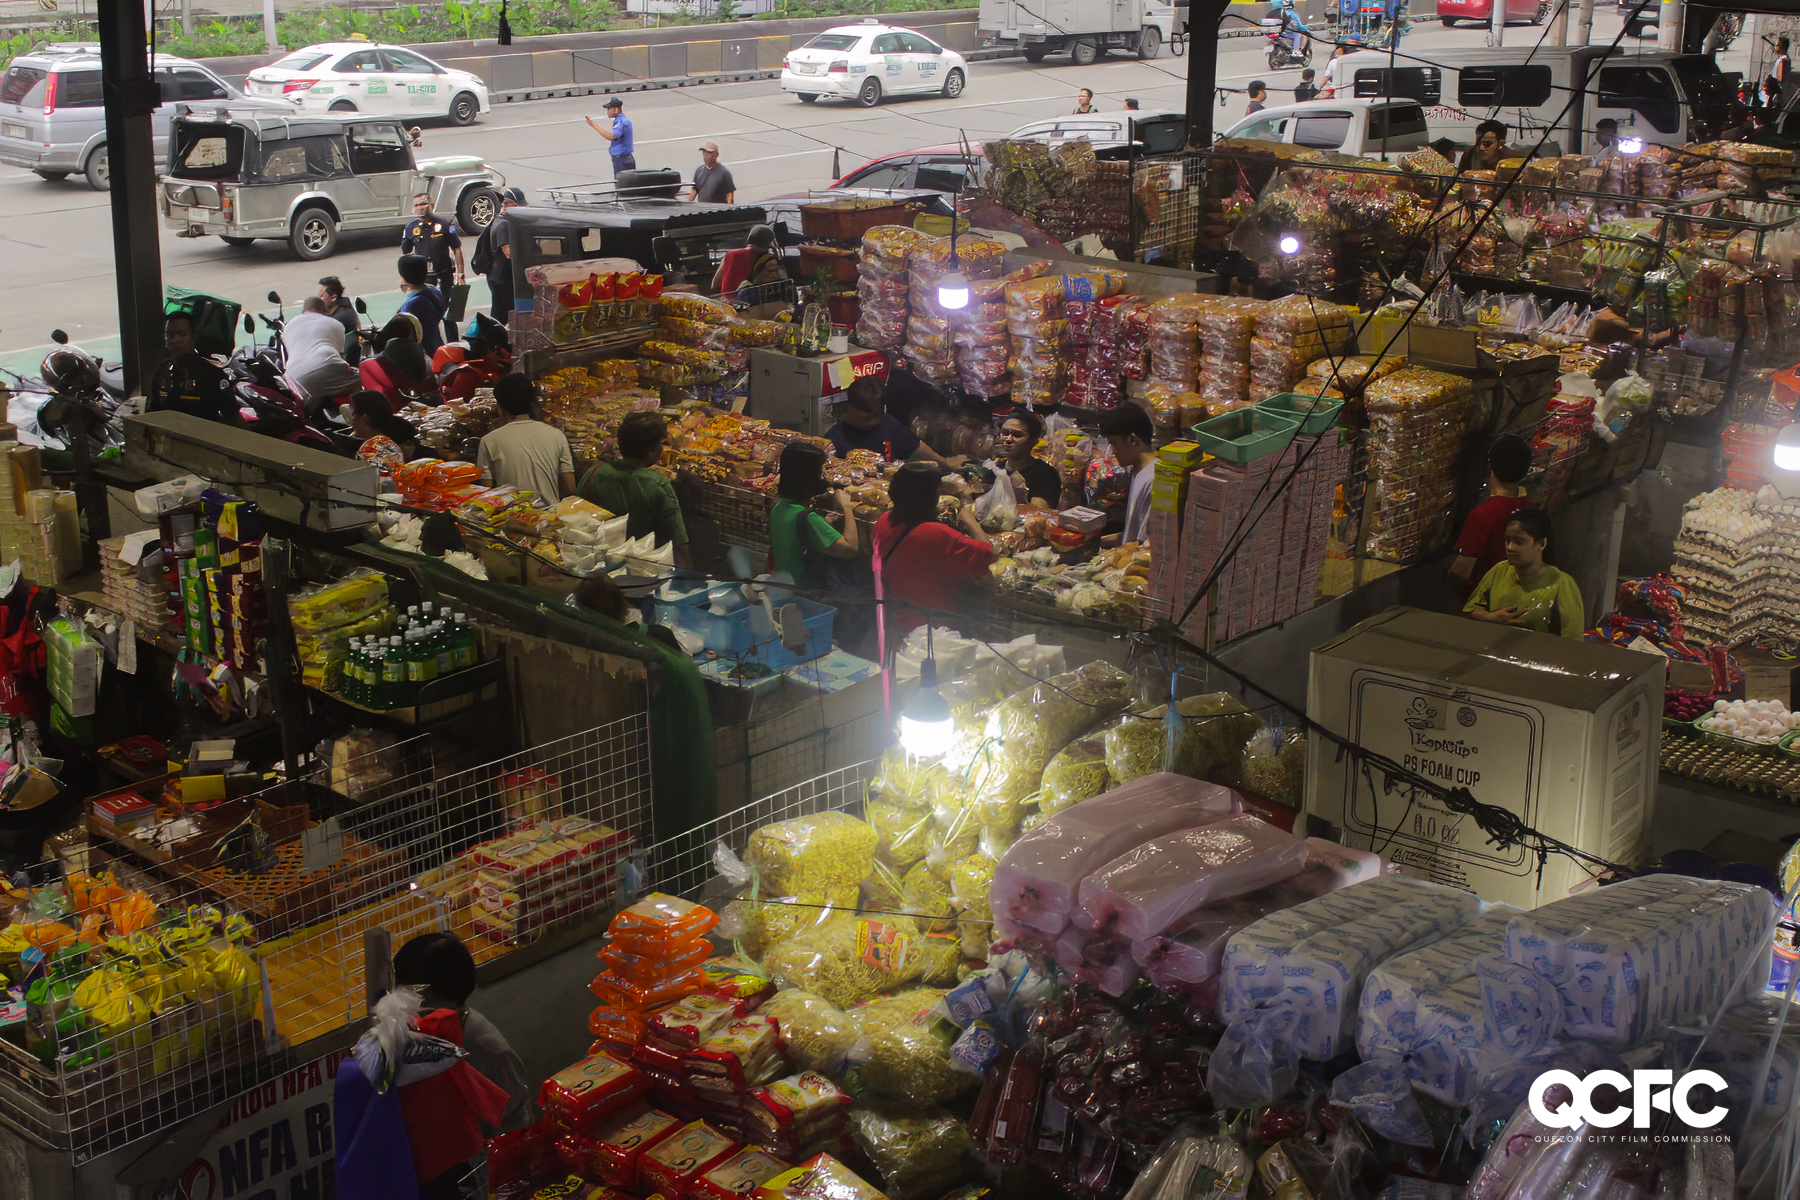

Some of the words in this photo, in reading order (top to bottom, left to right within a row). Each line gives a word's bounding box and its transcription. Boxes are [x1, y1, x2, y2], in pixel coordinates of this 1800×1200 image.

[1404, 754, 1418, 772] PS
[1421, 759, 1453, 781] FOAM
[1457, 768, 1481, 787] CUP
[283, 1060, 322, 1100] NFA
[218, 1119, 298, 1199] NFA
[304, 1102, 333, 1158] R
